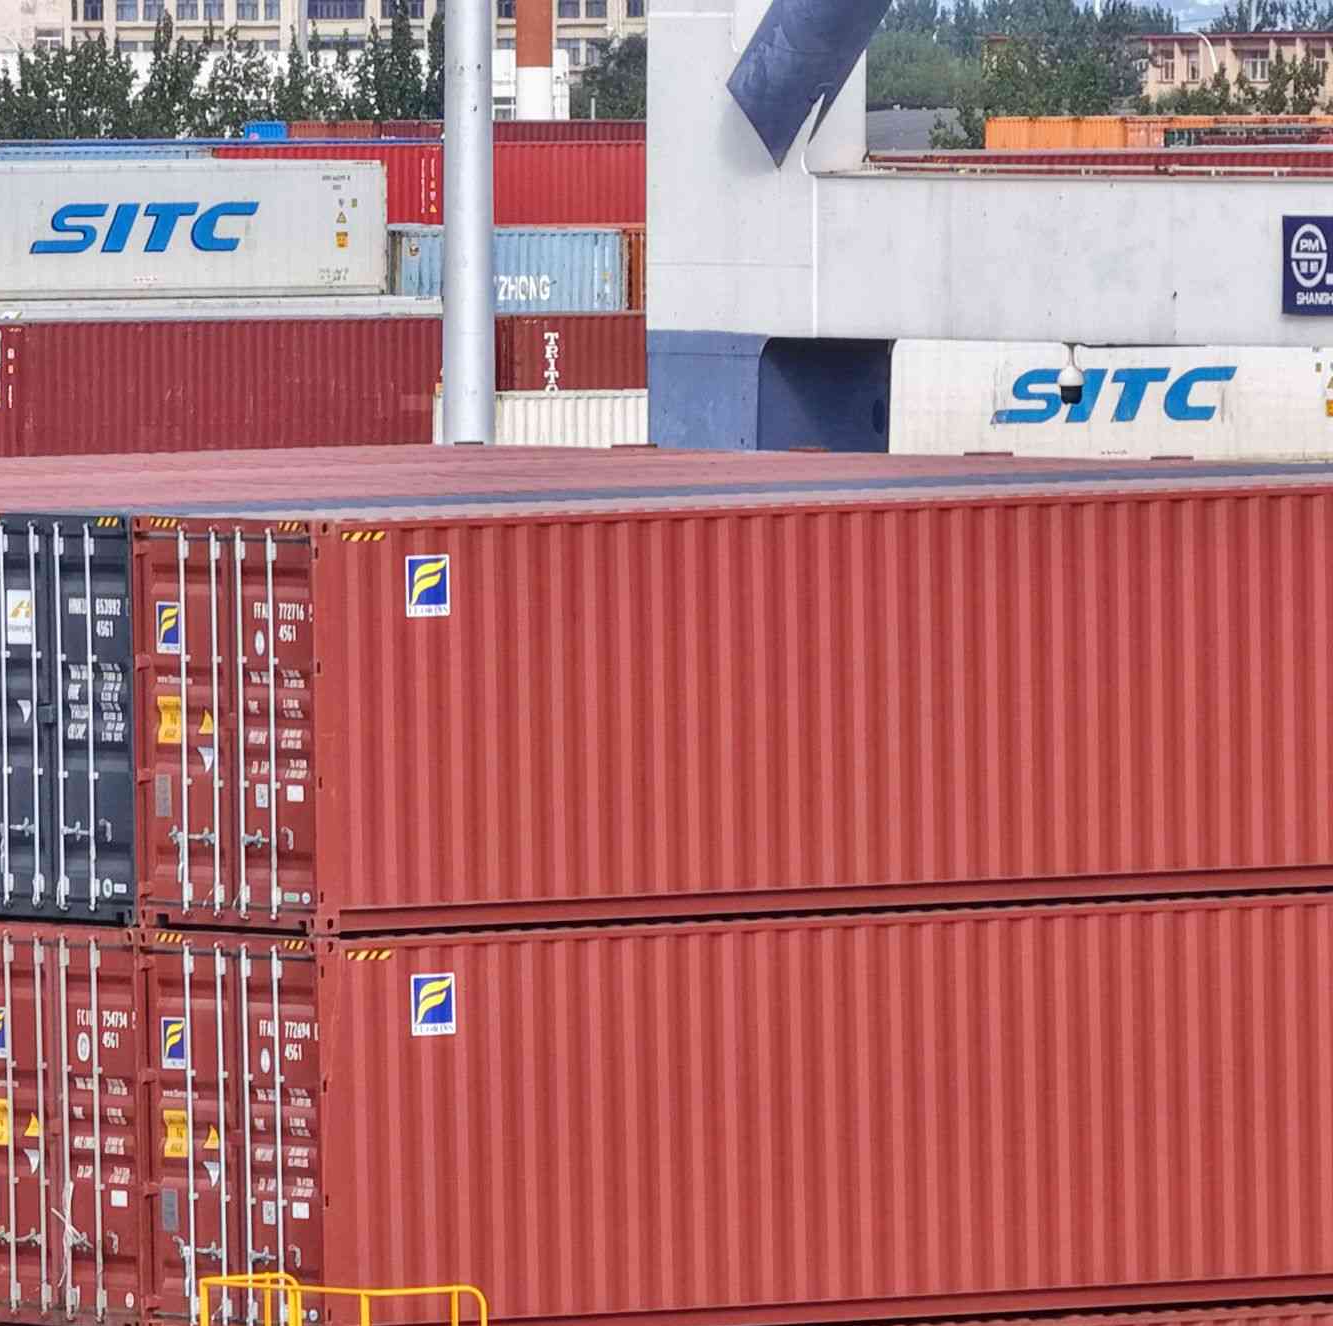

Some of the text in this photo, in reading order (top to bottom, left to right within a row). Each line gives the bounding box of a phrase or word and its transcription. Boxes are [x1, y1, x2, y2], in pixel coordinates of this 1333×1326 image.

[30, 202, 259, 253] SITC
[499, 274, 551, 302] ZHONG
[991, 365, 1237, 424] SITC
